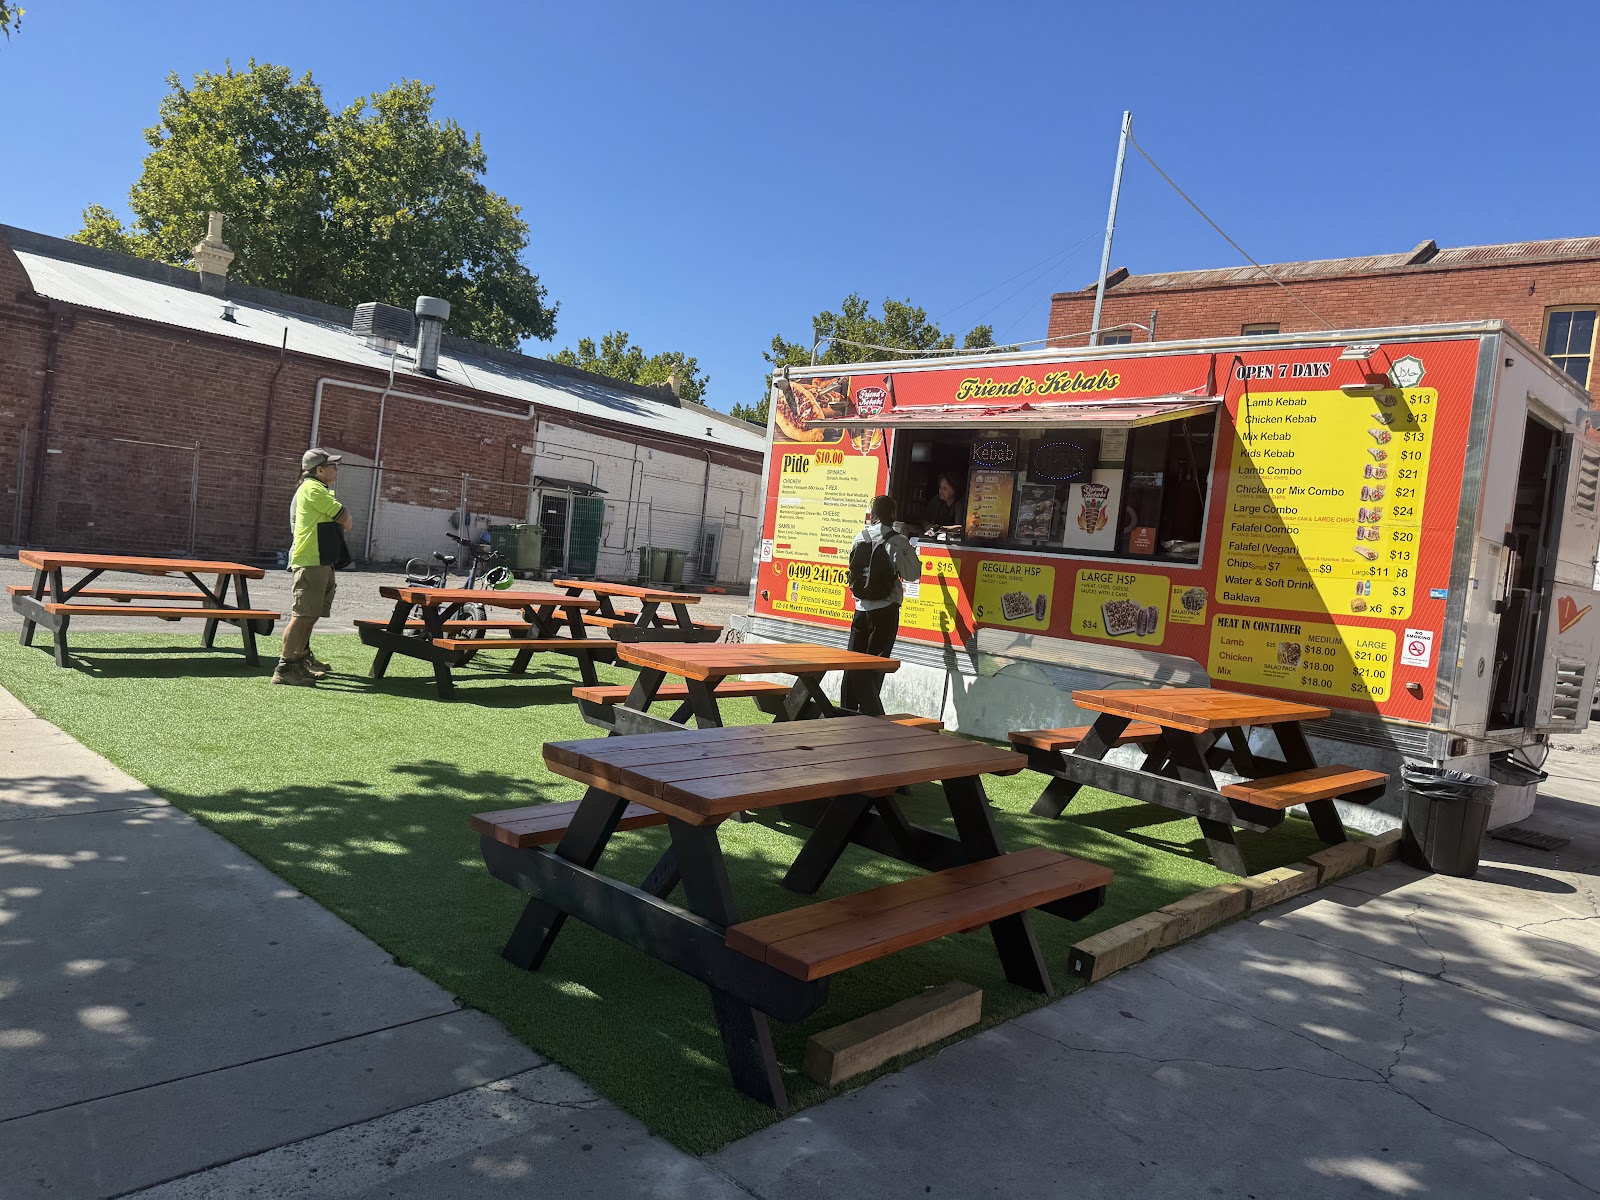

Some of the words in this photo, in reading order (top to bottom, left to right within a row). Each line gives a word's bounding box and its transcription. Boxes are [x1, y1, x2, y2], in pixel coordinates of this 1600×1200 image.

[1236, 365, 1274, 380] OPEN
[1278, 364, 1288, 378] 7
[1292, 362, 1330, 378] DAYS
[957, 377, 1034, 400] Friend's
[1039, 371, 1119, 393] Kebabs
[1246, 398, 1273, 406] Lamb
[1276, 397, 1307, 406] Kebab
[1410, 394, 1430, 405] $13
[1245, 415, 1282, 424] Chicken
[1285, 414, 1316, 423] Kebab
[1406, 414, 1427, 424] $13
[1242, 432, 1258, 440] Mix
[1260, 432, 1291, 441] Kebab
[1404, 432, 1424, 443] $13
[973, 443, 1014, 460] Kebab
[1240, 449, 1261, 458] Kids
[1264, 449, 1294, 458] Kebab
[1401, 450, 1421, 462] $10
[815, 451, 844, 464] $10.00
[783, 455, 809, 473] Pide
[1238, 466, 1264, 474] Lamb
[1267, 466, 1302, 475] Combo
[1398, 469, 1418, 480] $21
[1236, 485, 1274, 494] Chicken
[1289, 486, 1305, 495] Mix
[1308, 487, 1344, 496] Combo
[1396, 487, 1415, 498] $21
[1234, 504, 1260, 514] Large
[1263, 504, 1298, 514] Combo
[1393, 506, 1413, 517] $24
[1231, 523, 1262, 532] Falafel
[1264, 524, 1299, 534] Combo
[1393, 531, 1413, 542] $20
[1229, 542, 1259, 552] Falafel
[1262, 543, 1299, 555] (Vegan)
[1390, 550, 1410, 561] $13
[789, 564, 811, 579] 0499
[813, 566, 829, 581] 241
[937, 562, 952, 572] $15
[983, 563, 1021, 574] REGULAR
[1025, 567, 1041, 576] HSP
[1227, 558, 1252, 569] Chips
[1268, 562, 1280, 572] $7
[1320, 564, 1332, 575] $9
[1369, 566, 1388, 576] $11
[1081, 571, 1114, 583] LARGE
[1117, 574, 1136, 585] HSP
[1225, 575, 1252, 585] Water
[1255, 577, 1262, 586] &
[1265, 578, 1284, 588] Soft
[1287, 579, 1314, 590] Drink
[801, 585, 821, 594] FRIENDS
[822, 587, 841, 595] KEBABS
[1392, 586, 1406, 597] $3
[801, 596, 821, 604] FRIENDS
[822, 598, 841, 607] KEBABS
[1224, 592, 1260, 603] Baklava
[789, 604, 802, 612] Myers
[804, 606, 818, 614] street
[977, 604, 984, 619] $
[1369, 604, 1382, 613] x6
[1390, 606, 1404, 616] $7
[1082, 620, 1097, 629] $34
[1217, 617, 1239, 628] MEAT
[1241, 620, 1250, 630] IN
[1253, 621, 1301, 634] CONTAINER
[1220, 637, 1244, 647] Lamb
[1308, 635, 1343, 645] MEDIUM
[1357, 640, 1386, 650] LARGE
[1219, 652, 1252, 662] Chicken
[1304, 645, 1335, 656] $18.00
[1354, 651, 1388, 662] $21.00
[1217, 666, 1232, 675] Mix
[1303, 661, 1334, 673] $18.00
[1352, 667, 1385, 678] $21.00
[1302, 676, 1332, 688] $18.00
[1350, 683, 1384, 695] $21.00
